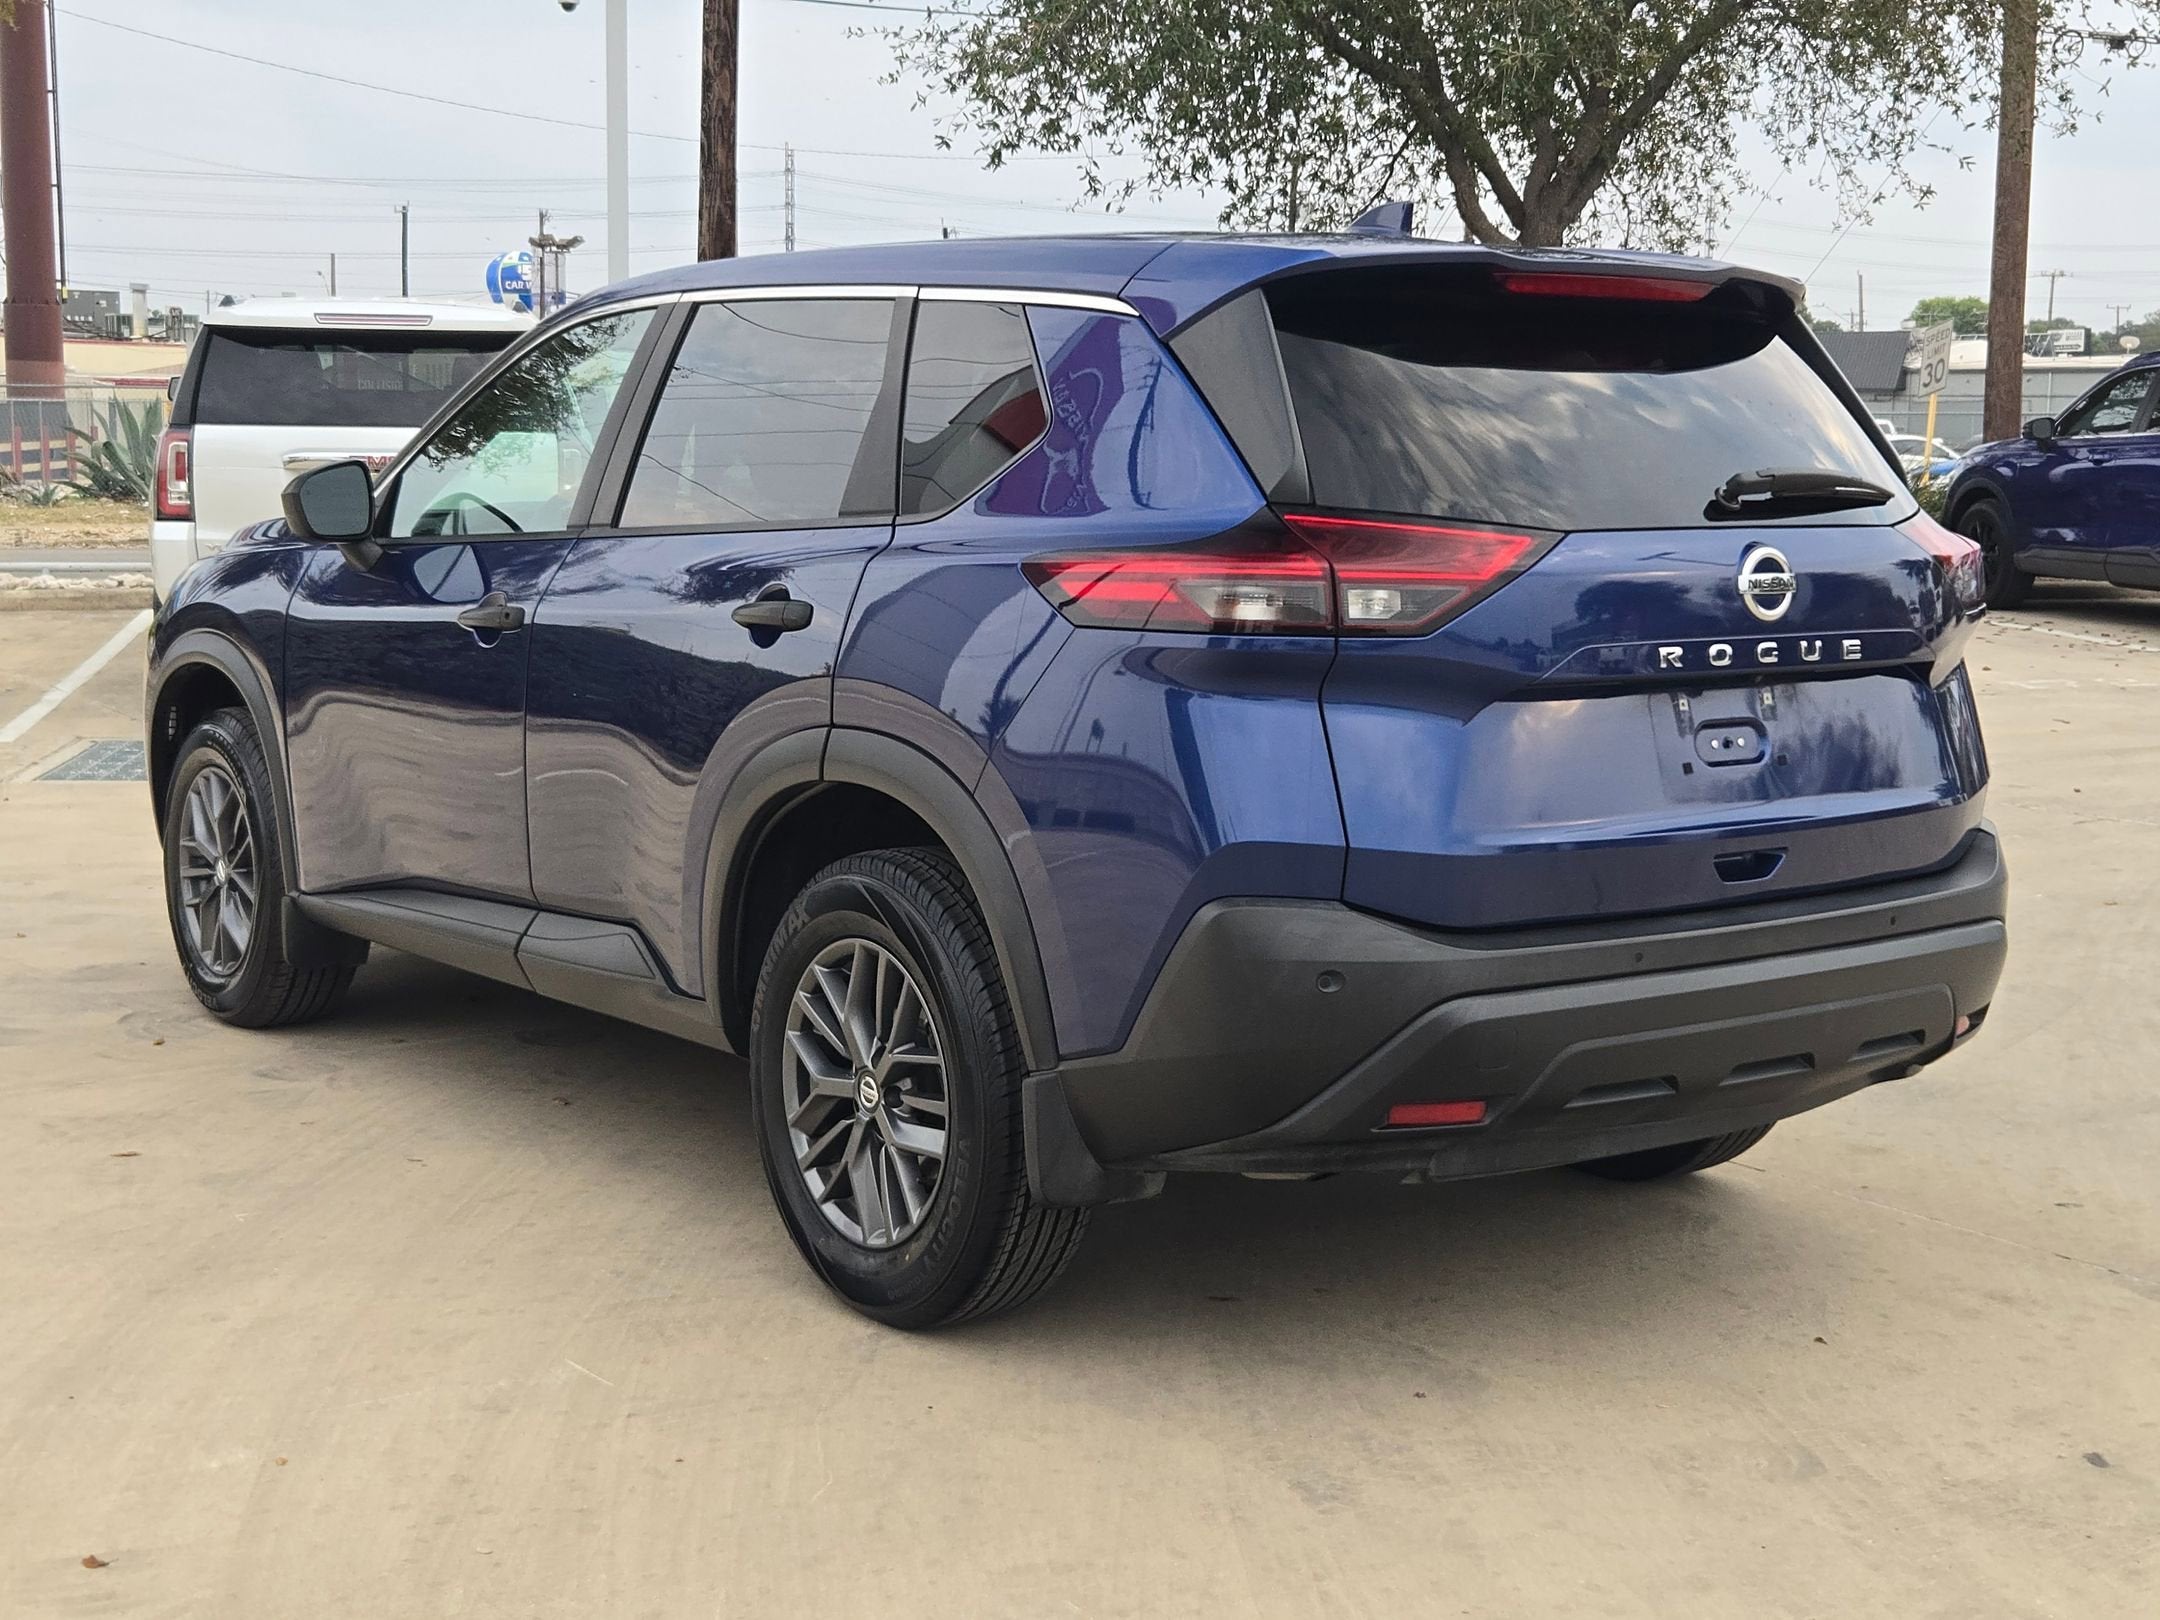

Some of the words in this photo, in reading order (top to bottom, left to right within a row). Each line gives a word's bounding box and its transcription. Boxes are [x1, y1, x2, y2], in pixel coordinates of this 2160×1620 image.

[505, 280, 524, 289] CAR
[1926, 328, 1951, 347] SPEED
[1925, 343, 1946, 360] LIMIT
[1922, 358, 1946, 388] 30
[1748, 576, 1794, 590] NISSAN
[1658, 639, 1862, 669] ROGUE
